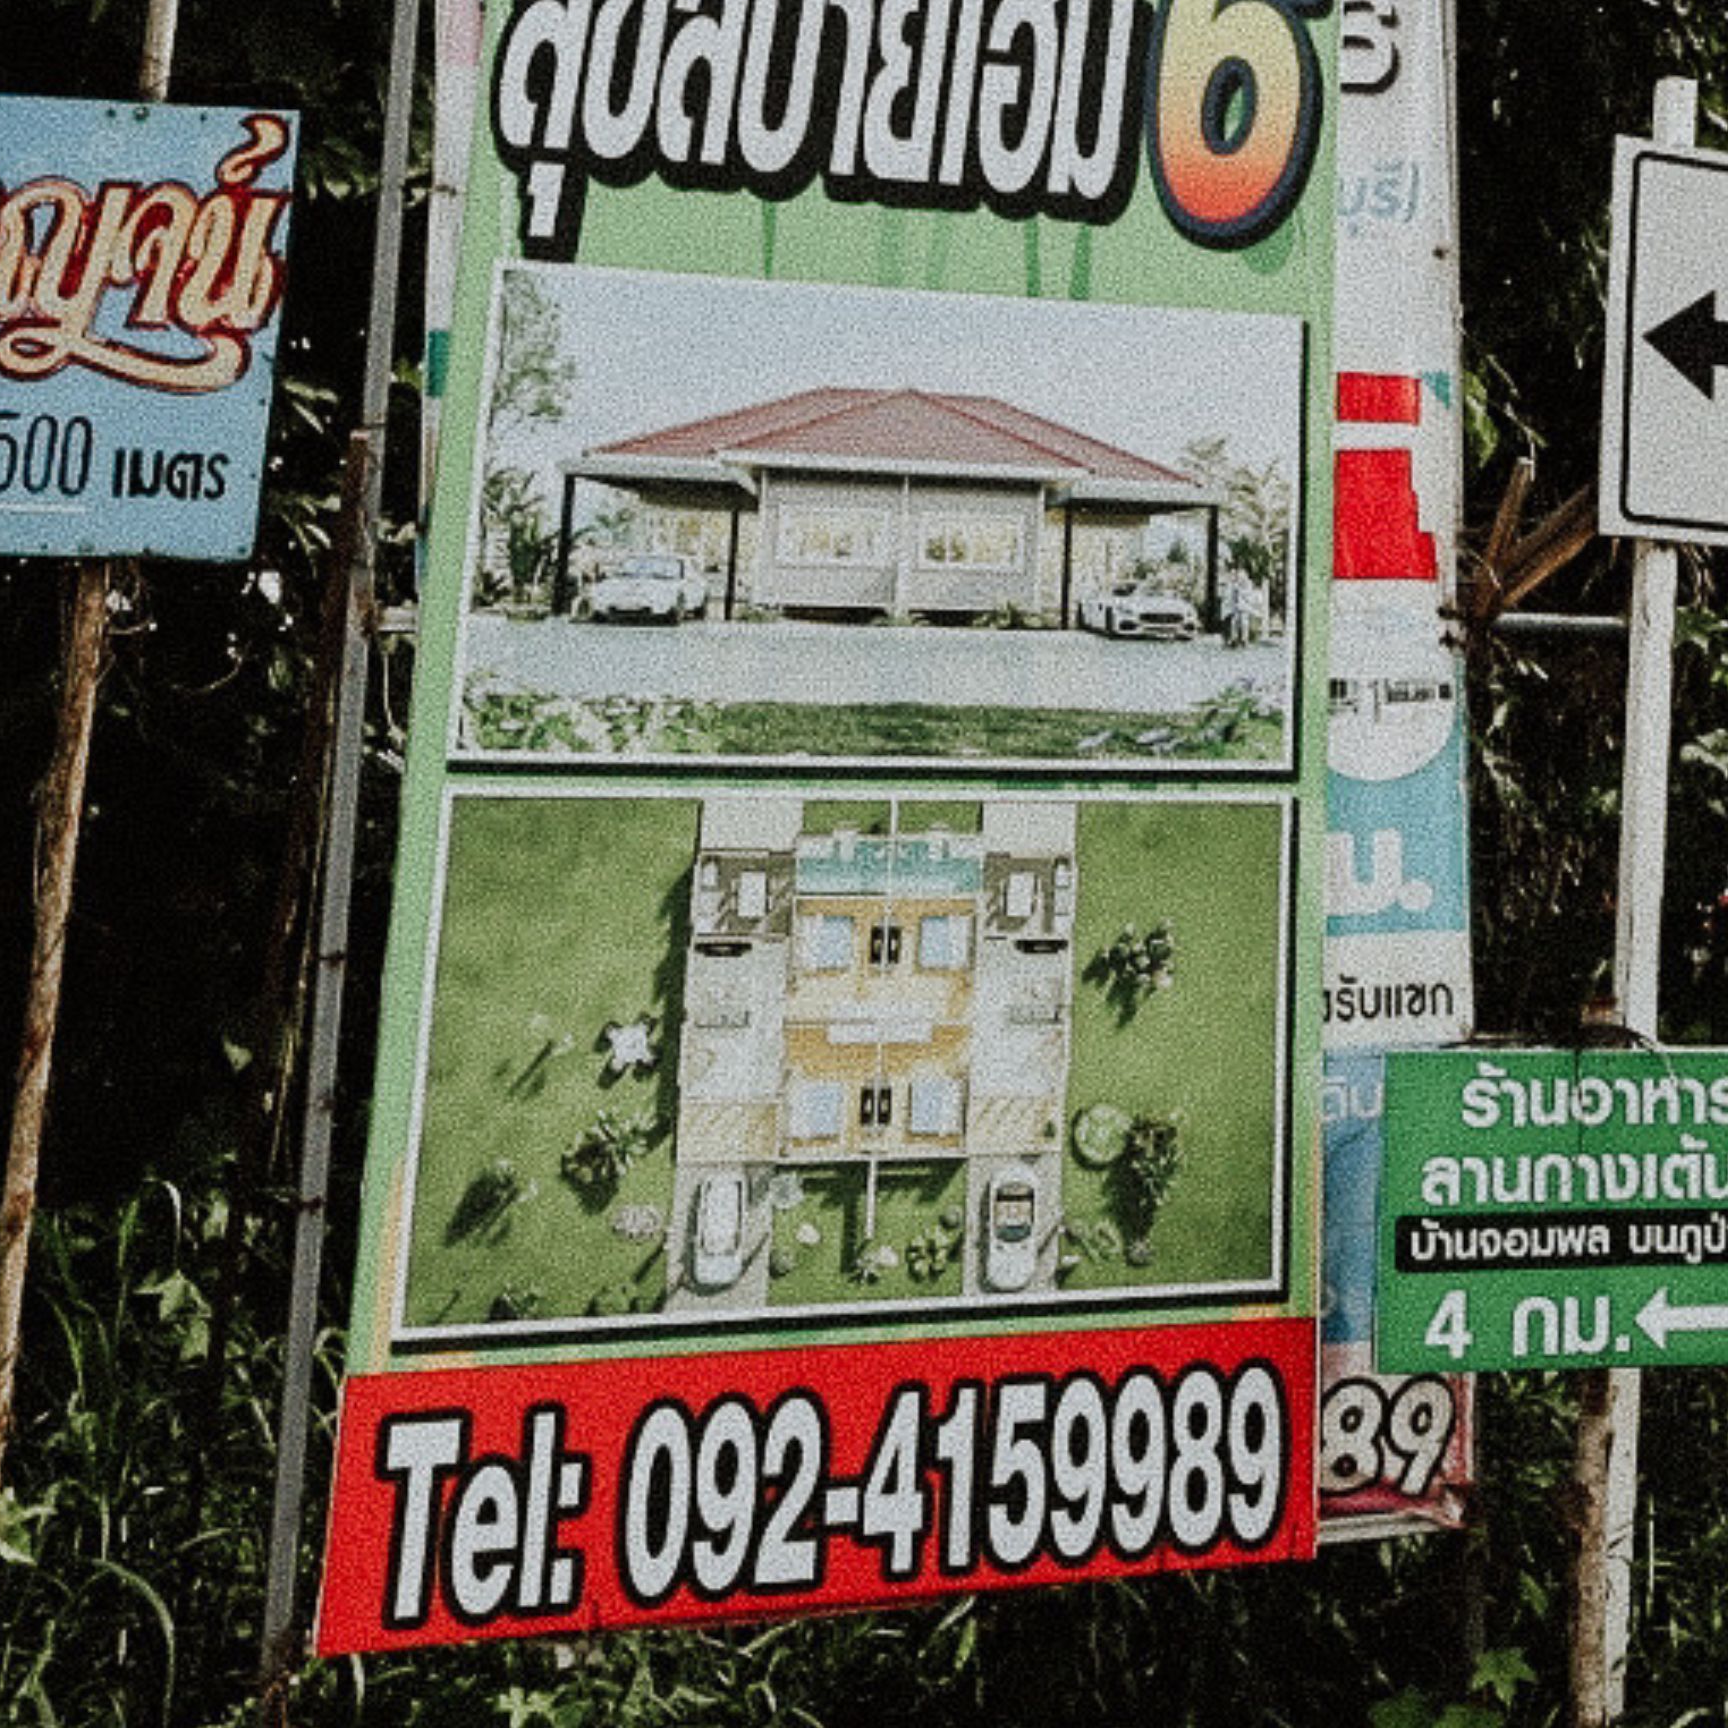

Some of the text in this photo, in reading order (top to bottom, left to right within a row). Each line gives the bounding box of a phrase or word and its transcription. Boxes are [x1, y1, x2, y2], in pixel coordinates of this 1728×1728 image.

[111, 447, 230, 501] เมตร
[1409, 1217, 1611, 1262] บ้านจอมพล
[1424, 1288, 1632, 1360] 4 กม.
[380, 1359, 1287, 1628] Tel: 092-4159989
